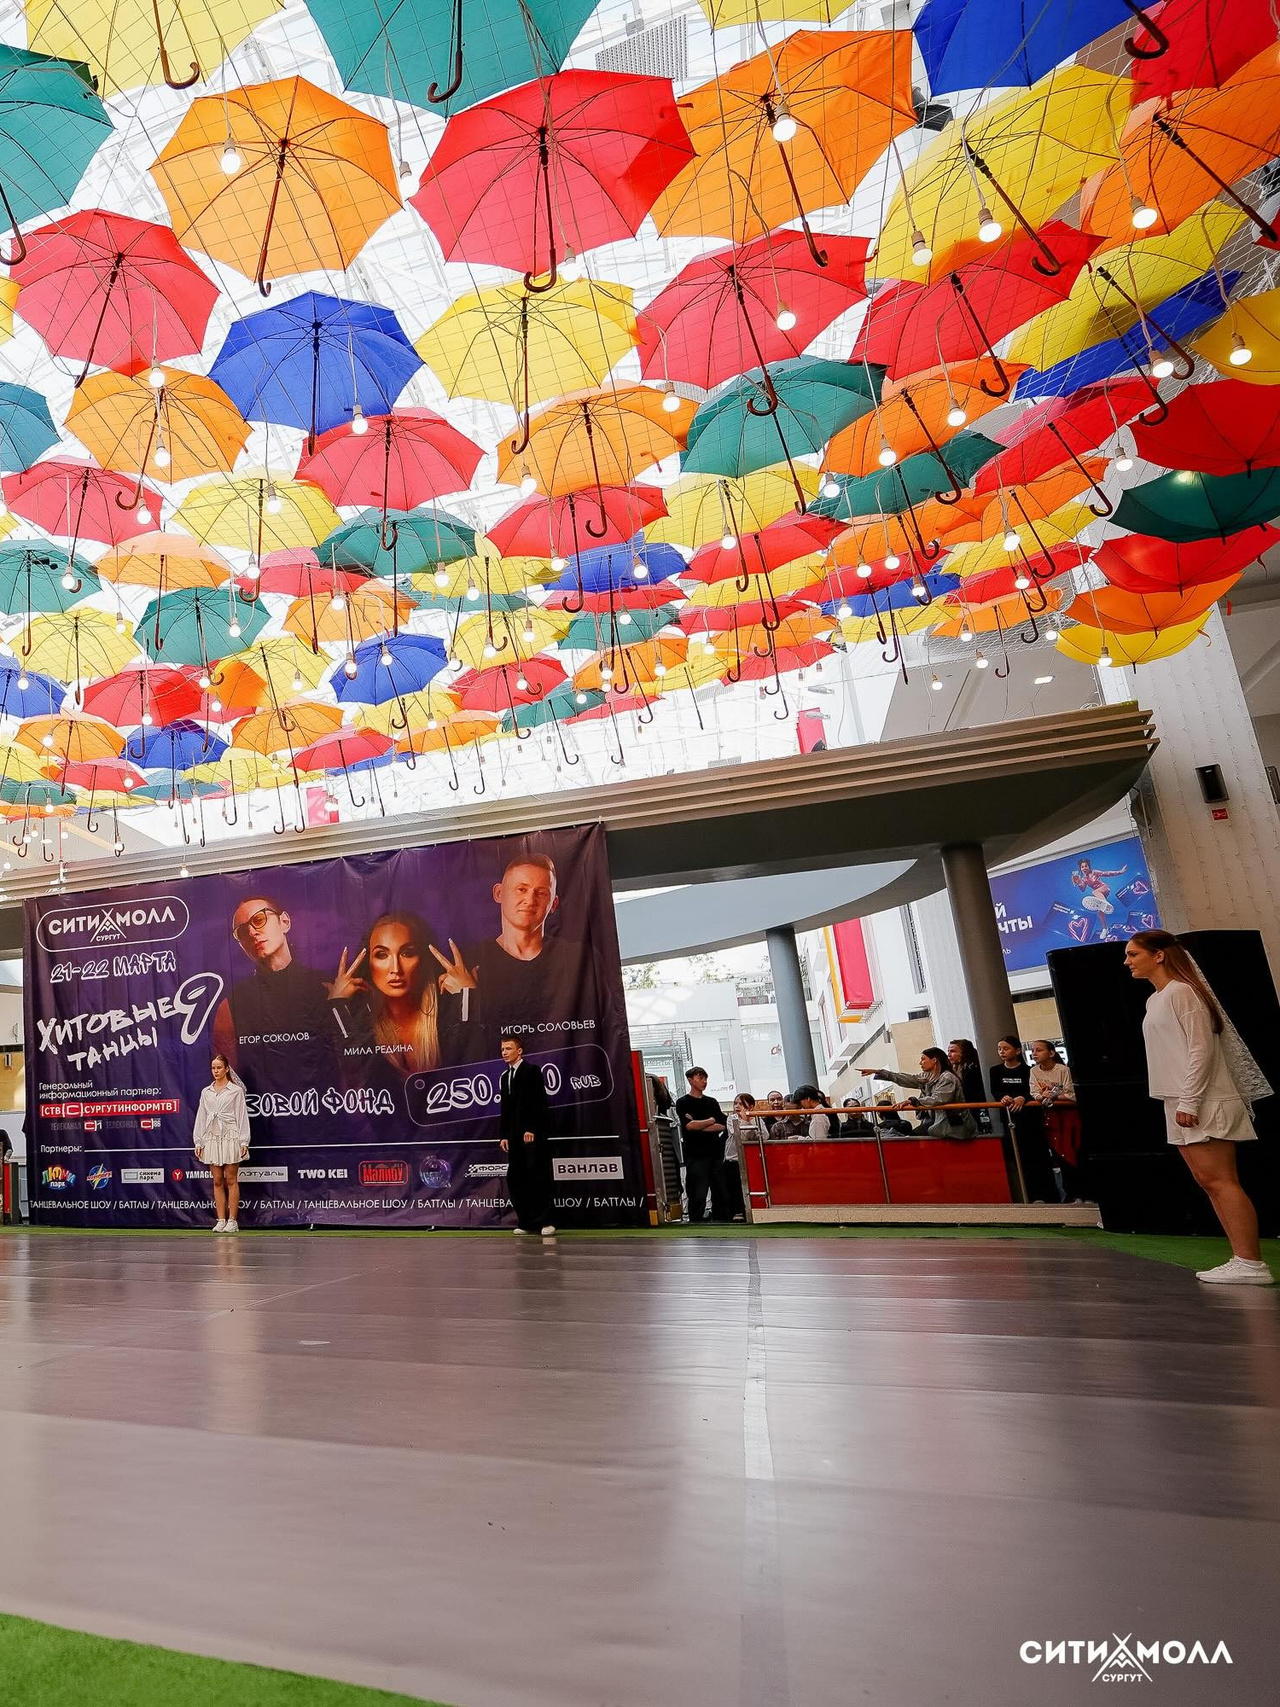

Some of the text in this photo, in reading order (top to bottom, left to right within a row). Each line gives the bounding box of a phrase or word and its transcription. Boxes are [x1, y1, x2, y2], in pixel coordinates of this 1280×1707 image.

[96, 934, 120, 942] СУРГУТ
[50, 950, 177, 984] 21-22 МАРТА
[173, 972, 224, 1045] 9
[500, 1020, 596, 1035] ИГОРЬ СОЛОВЬЕВ
[239, 1032, 310, 1045] ЕГОР СОКОЛОВ
[67, 1027, 158, 1071] ТАНЦЫ
[344, 1044, 414, 1056] МИЛА РЕДИНА
[38, 1080, 93, 1091] Генеральный
[39, 1087, 162, 1100] информационный партнер:
[246, 1088, 319, 1117] ЗОВОЙ
[40, 1145, 82, 1154] Партнеры:
[185, 1170, 214, 1179] YAMAGU
[298, 1169, 348, 1179] TWO KEI
[558, 1163, 618, 1174] ванлав
[30, 1200, 89, 1209] ТАНЦЕВАЛЬНОЕ
[90, 1200, 112, 1209] ШОУ
[120, 1200, 150, 1210] БАТТЛЫ
[157, 1200, 217, 1209] ТАНЦЕВАЛЬН
[260, 1200, 294, 1209] БАТТЛЫ
[304, 1200, 380, 1210] ТАНЦЕВАЛЬНОЕ
[382, 1199, 406, 1208] ШОУ
[418, 1199, 456, 1208] БАТТЛЫ
[554, 1198, 582, 1208] ШОУ
[594, 1198, 636, 1208] БАТТЛЫ
